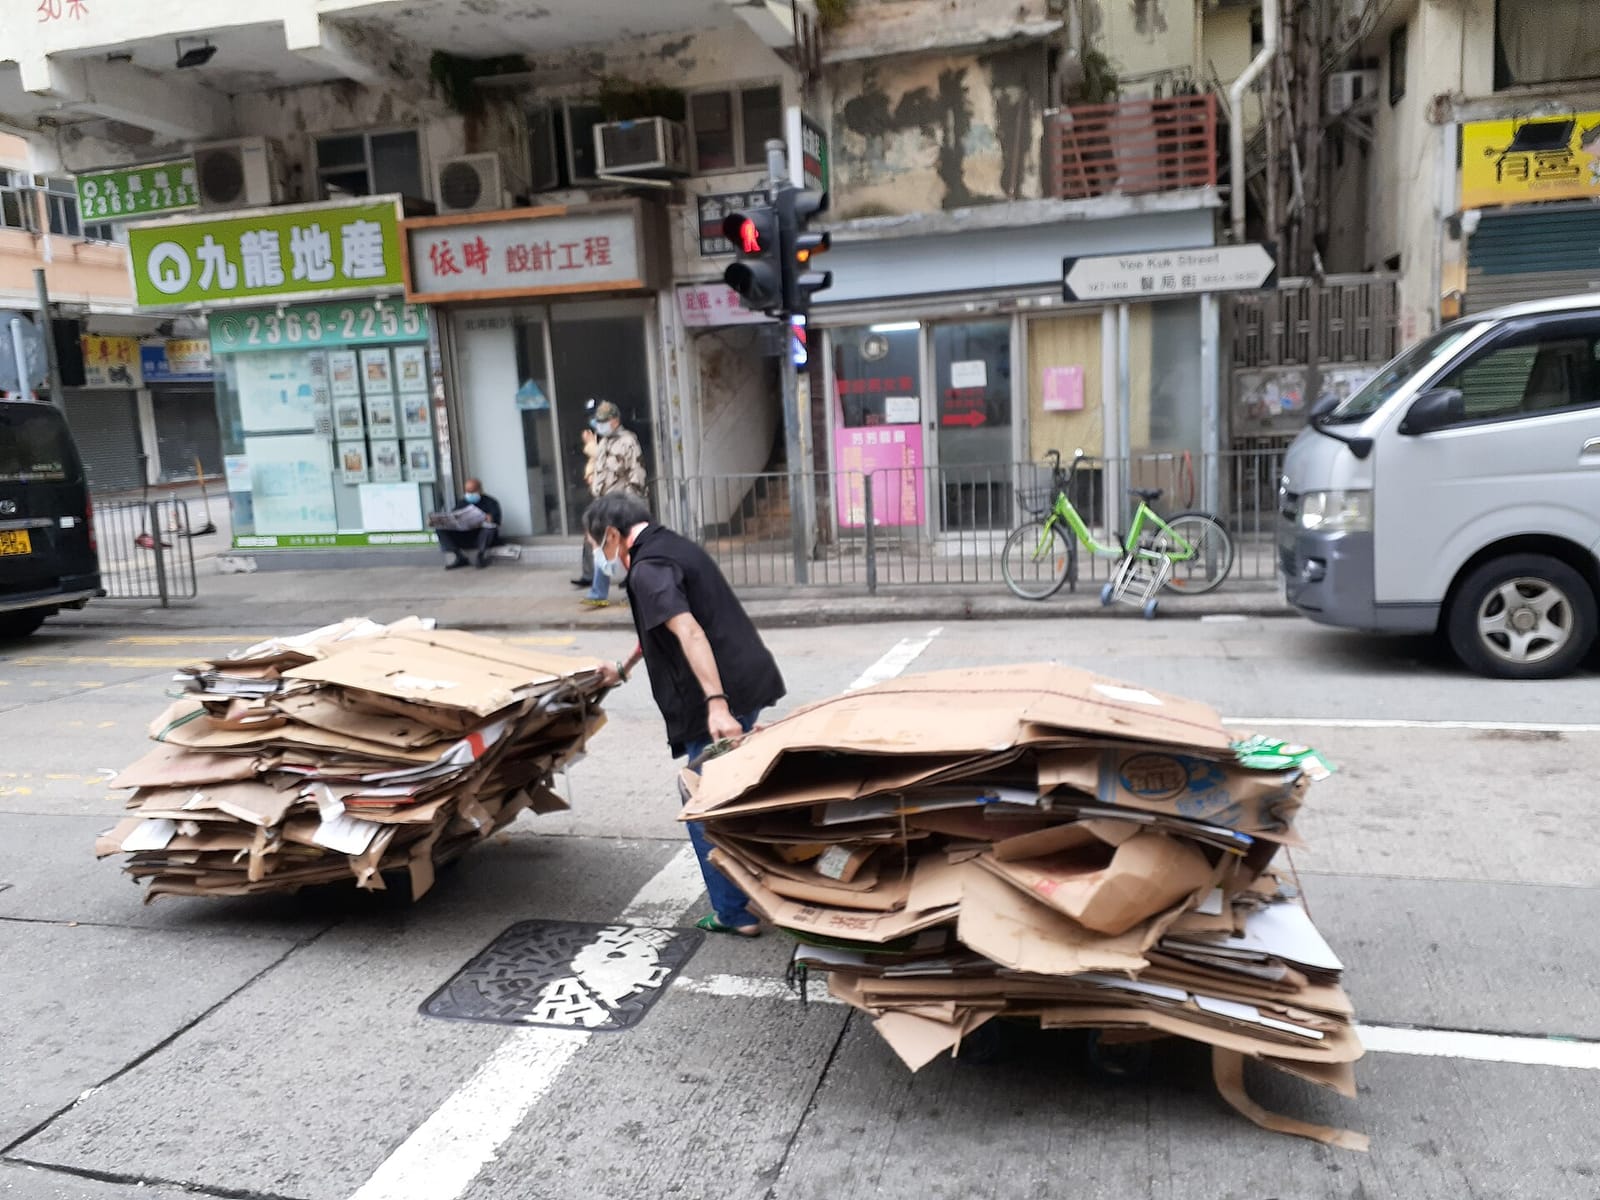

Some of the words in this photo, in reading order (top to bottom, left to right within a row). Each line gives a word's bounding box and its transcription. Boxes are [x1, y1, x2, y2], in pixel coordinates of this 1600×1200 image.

[429, 235, 492, 277] 依時
[505, 236, 613, 274] 設計工程
[246, 303, 420, 345] 2363-2255
